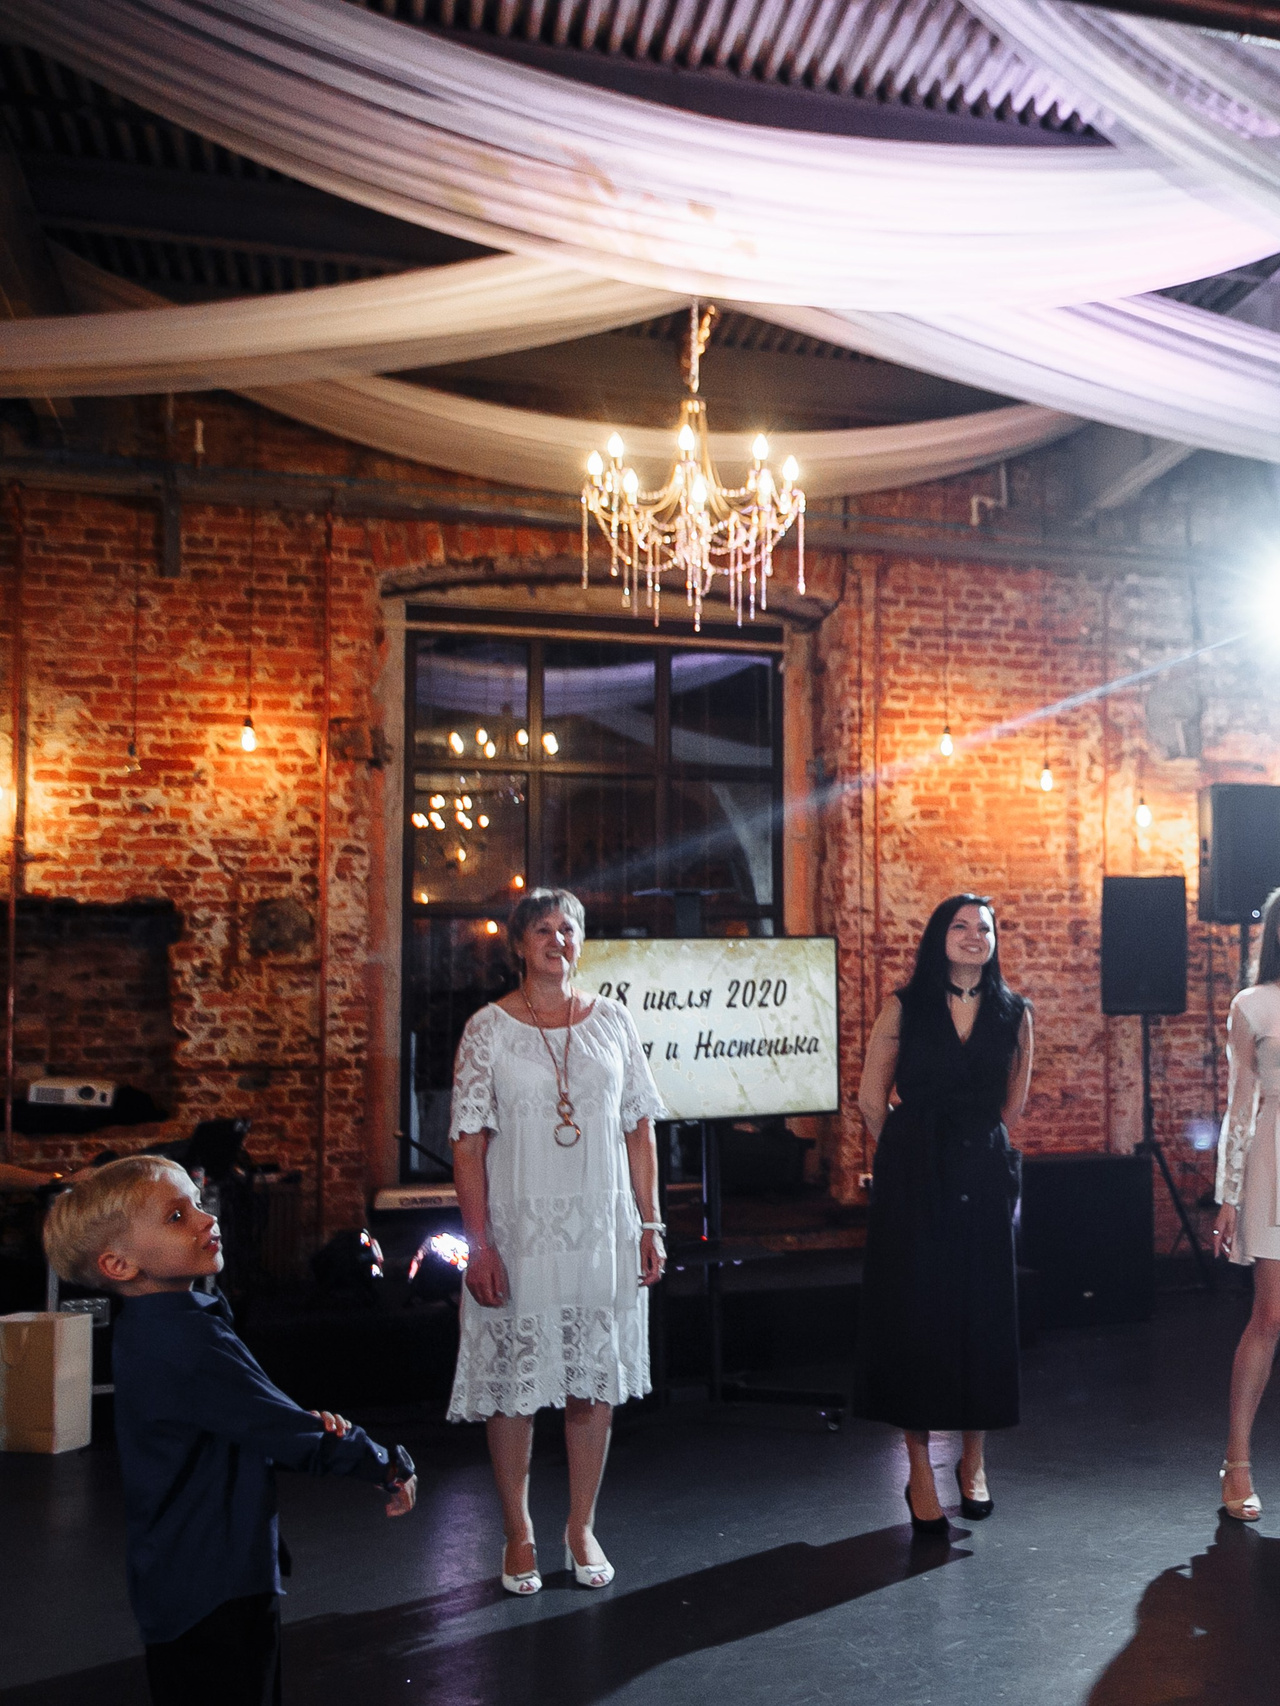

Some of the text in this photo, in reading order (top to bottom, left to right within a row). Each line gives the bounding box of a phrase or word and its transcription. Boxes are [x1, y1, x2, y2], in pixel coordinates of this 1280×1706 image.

[643, 989, 712, 1011] июля
[726, 978, 788, 1009] 2020
[665, 1041, 678, 1060] и
[694, 1029, 819, 1060] Настенька
